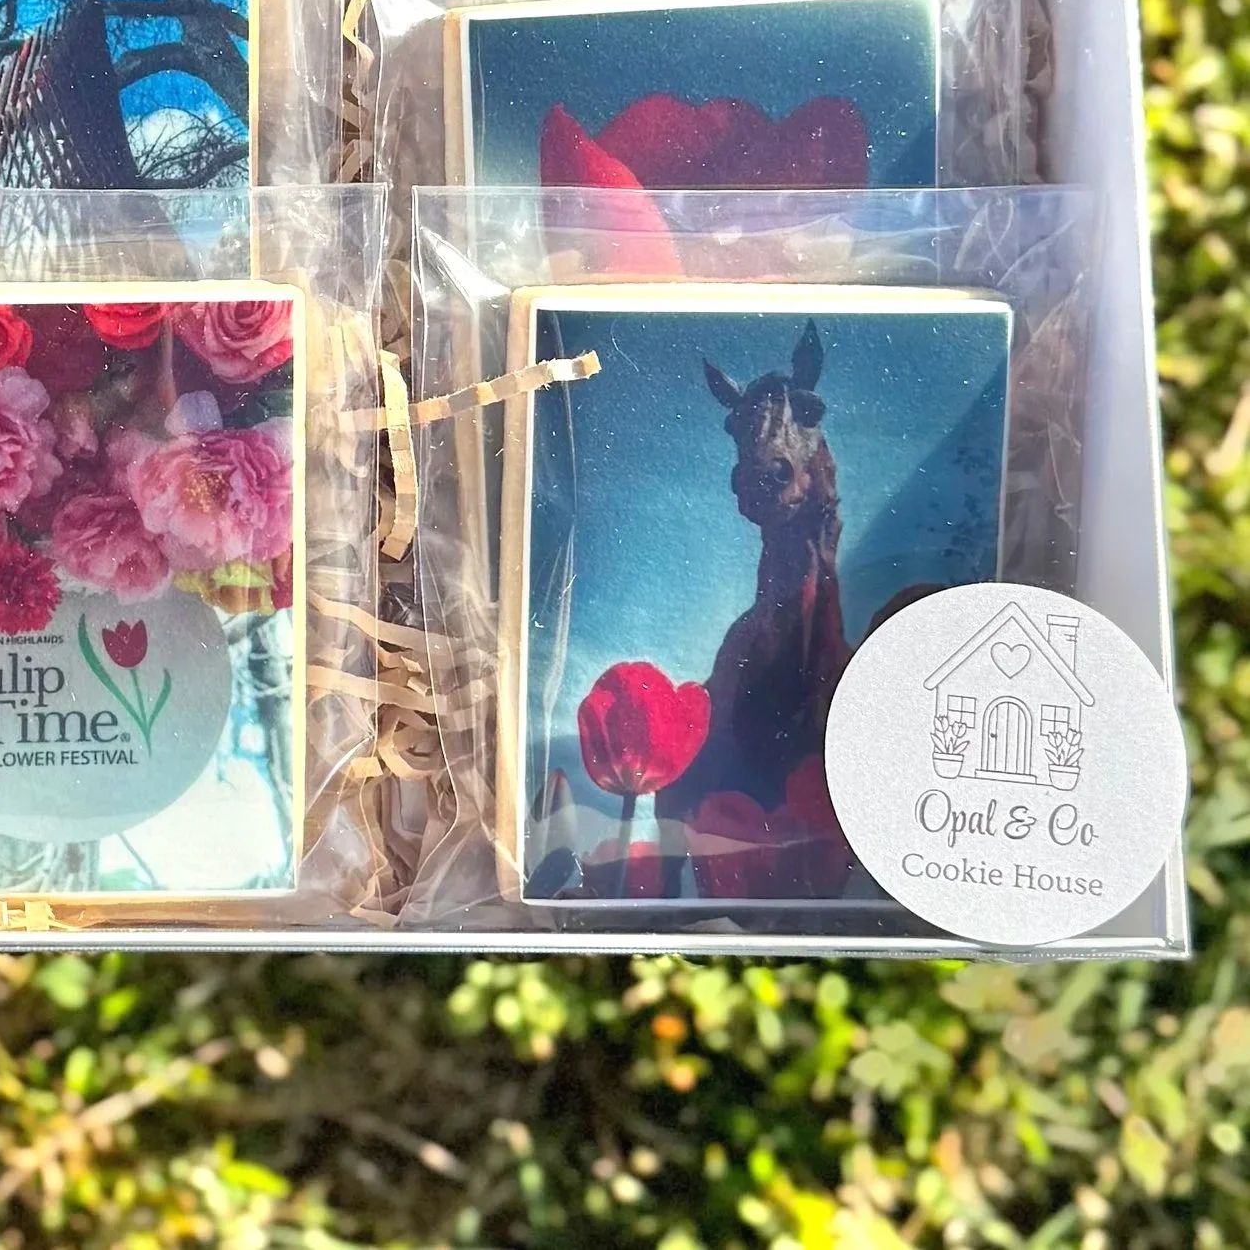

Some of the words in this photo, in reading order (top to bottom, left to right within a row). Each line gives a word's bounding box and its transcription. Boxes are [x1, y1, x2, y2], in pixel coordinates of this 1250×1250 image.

[6, 634, 65, 646] HIGHLANDS
[60, 749, 139, 766] FESTIVAL
[914, 788, 998, 848] Opal
[1003, 805, 1037, 840] &
[1048, 803, 1099, 846] Co
[901, 852, 1003, 886] Cookie
[1013, 863, 1103, 896] House
